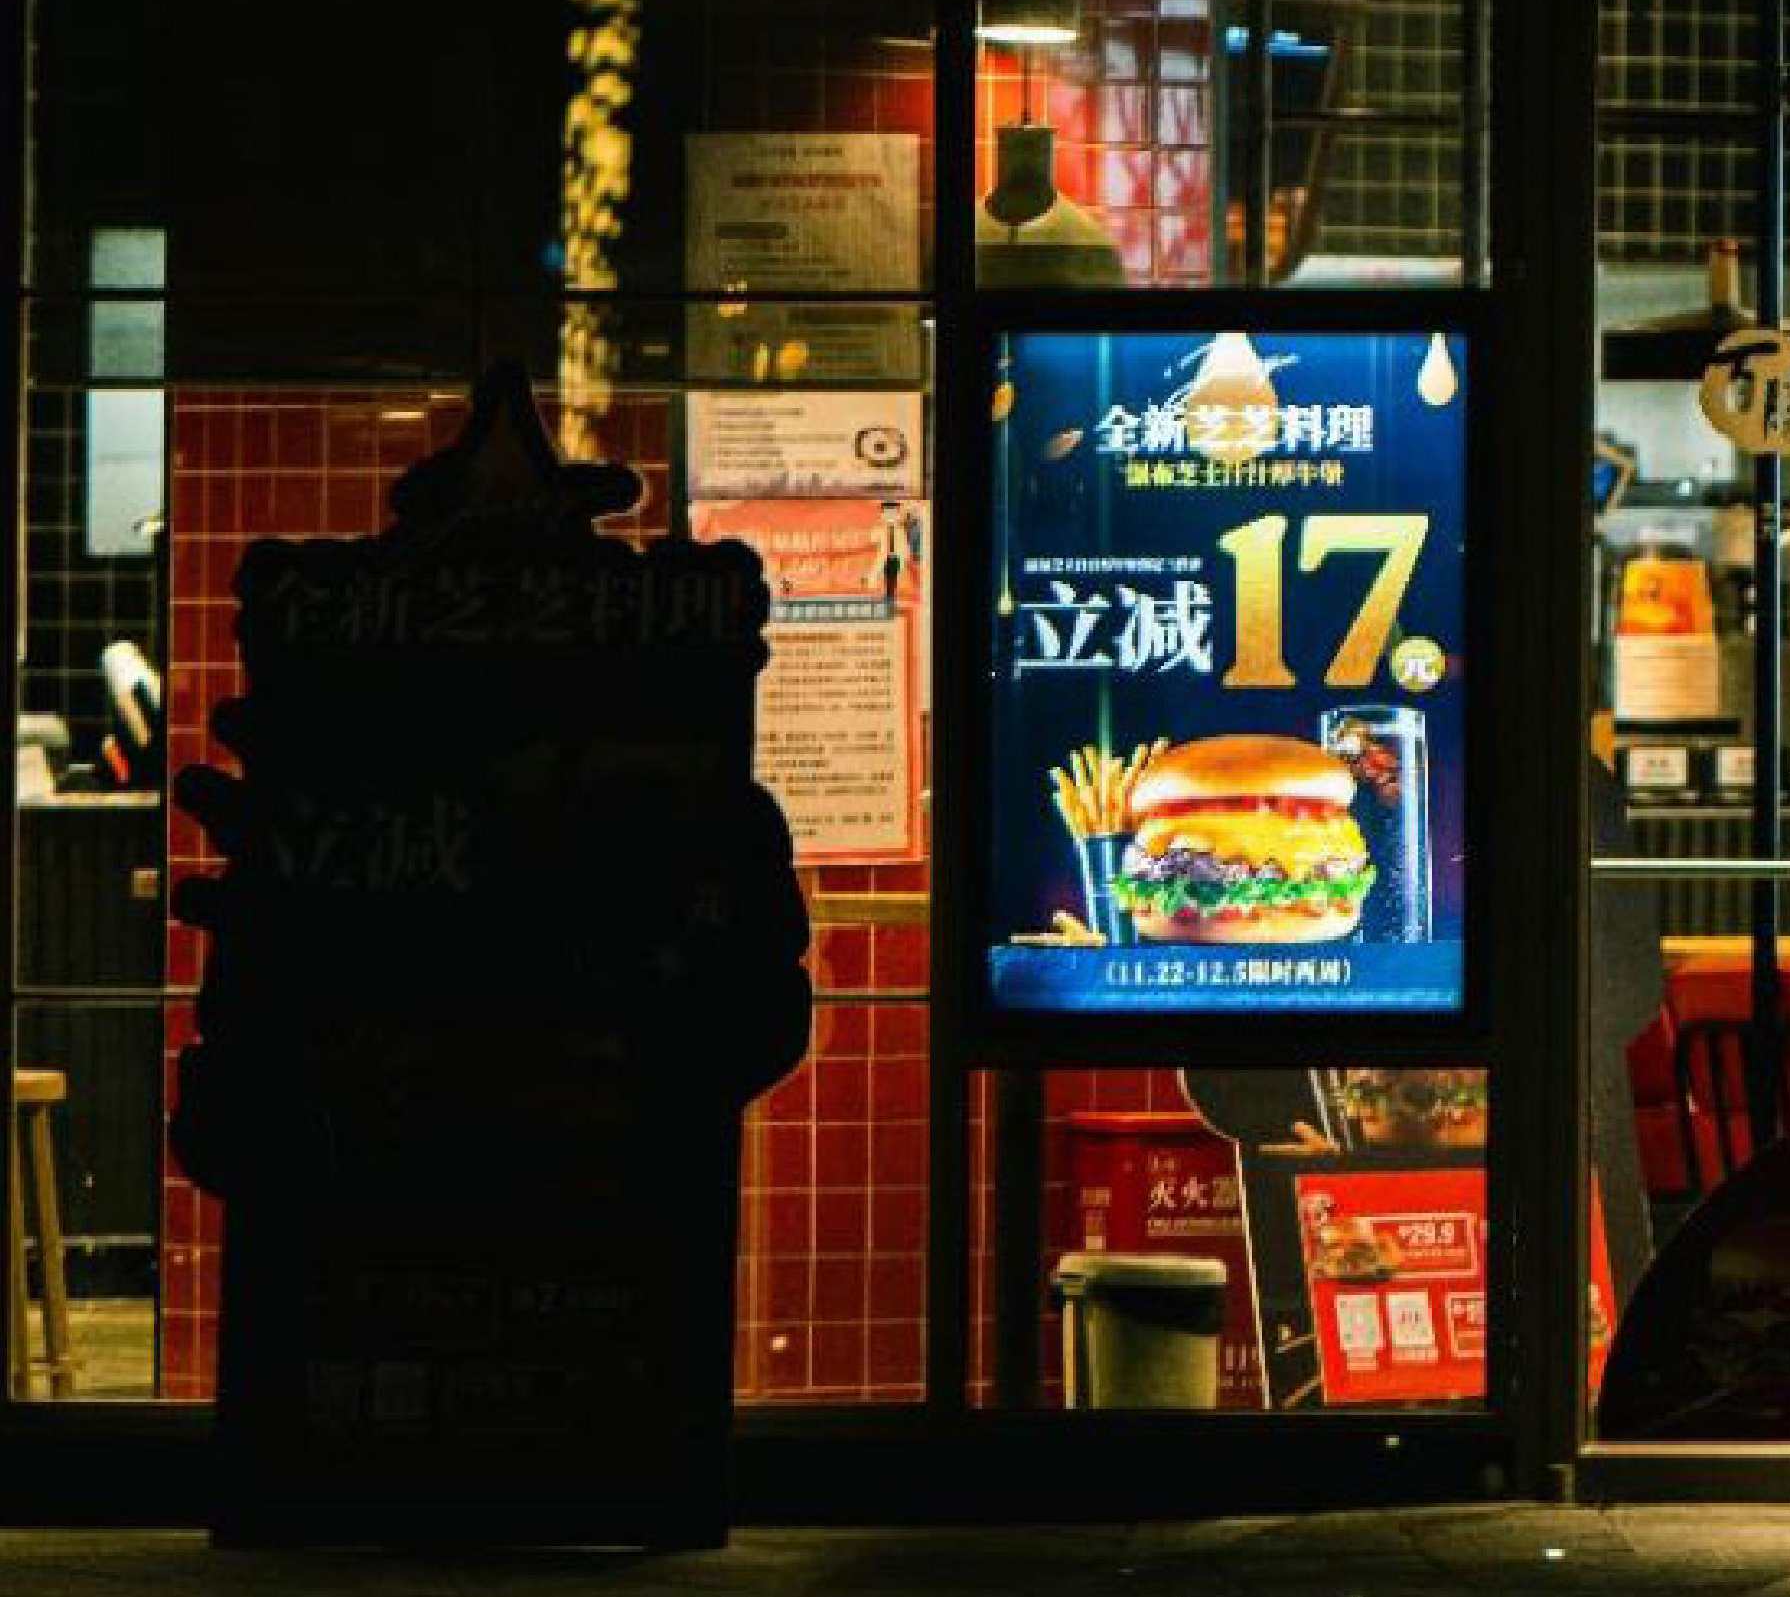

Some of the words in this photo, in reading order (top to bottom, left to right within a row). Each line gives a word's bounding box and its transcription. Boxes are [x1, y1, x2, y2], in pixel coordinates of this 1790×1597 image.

[1094, 403, 1375, 454] 全新芝芝料理
[1014, 578, 1214, 674] 立减
[1217, 512, 1430, 690] 17
